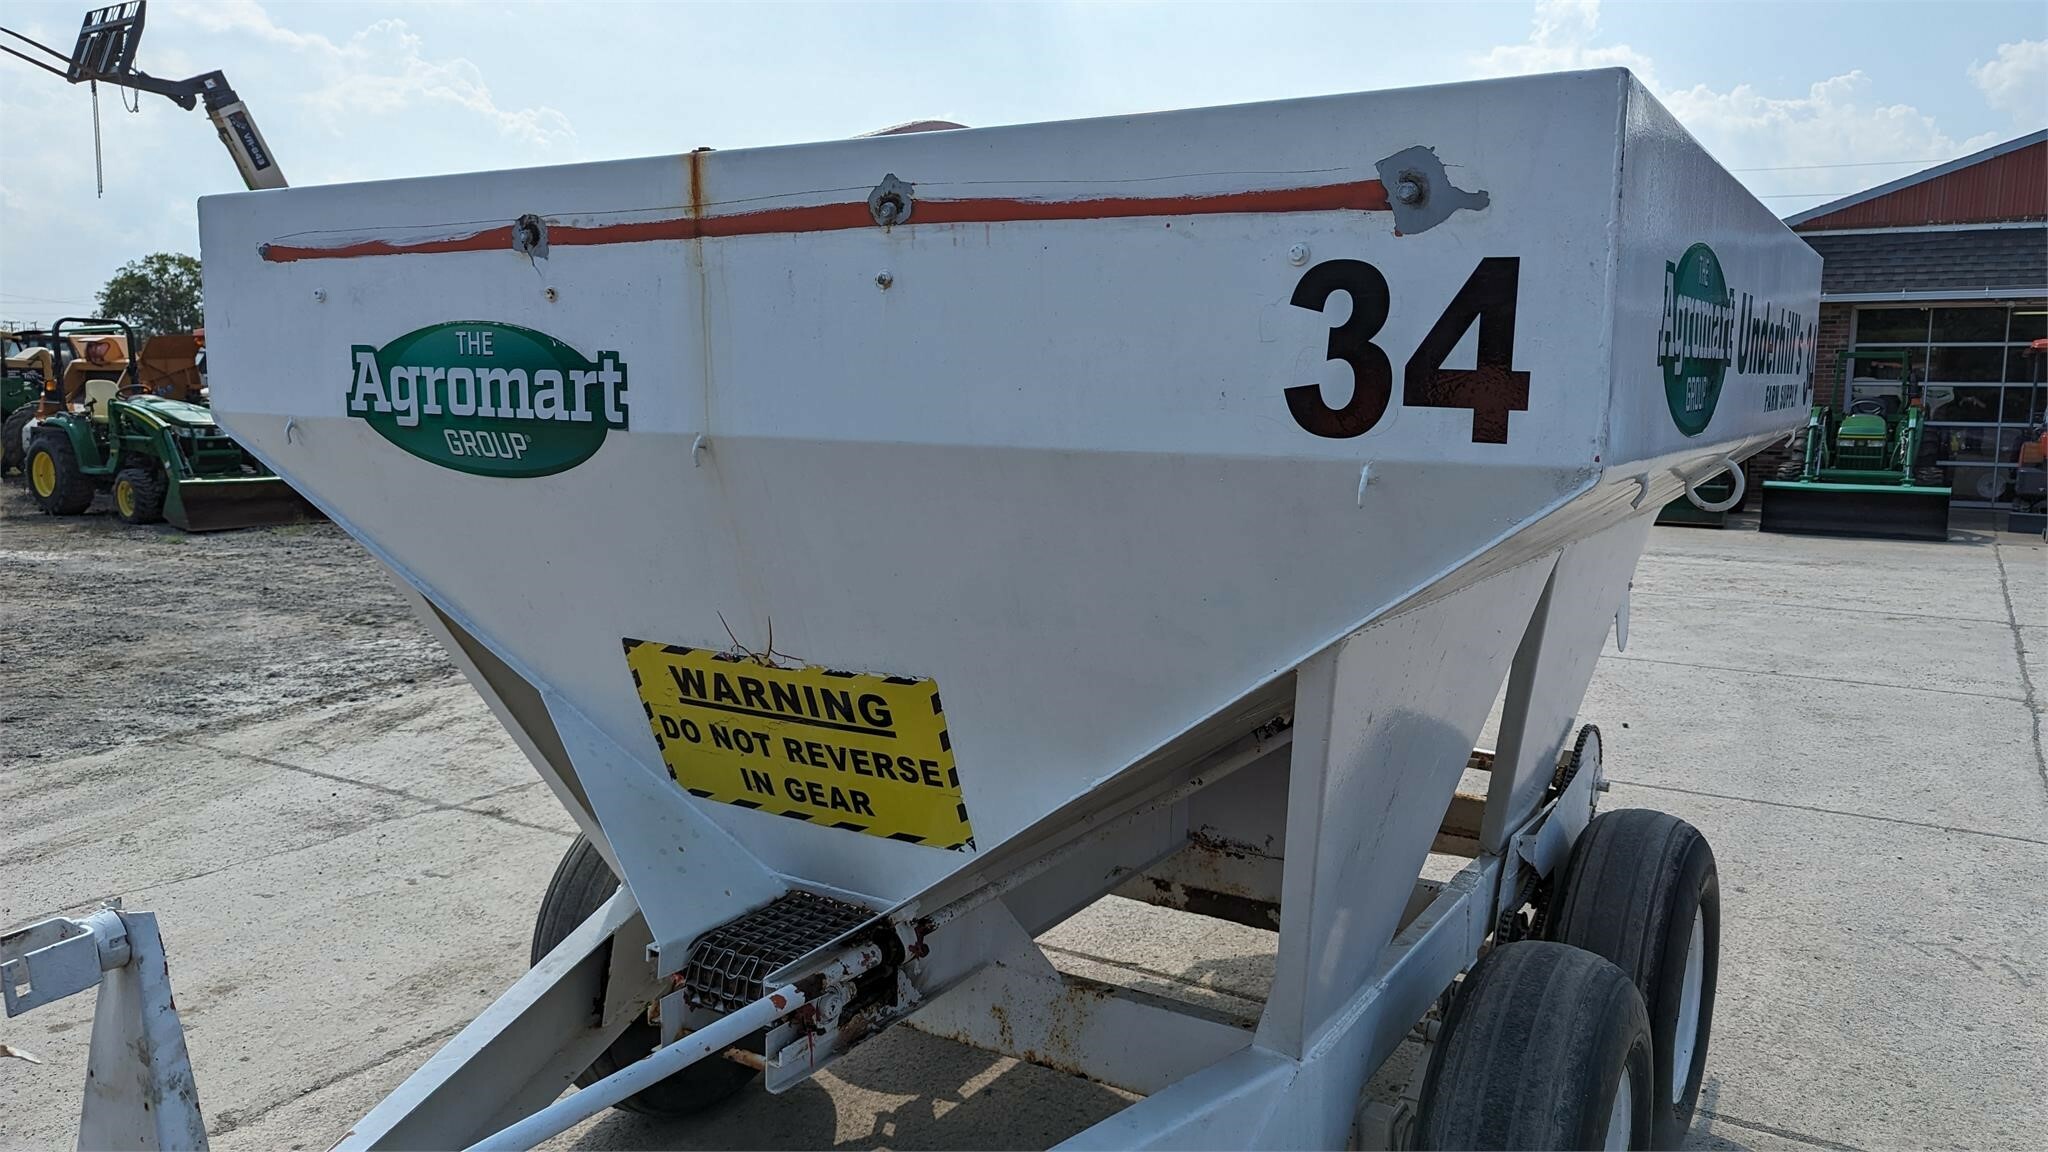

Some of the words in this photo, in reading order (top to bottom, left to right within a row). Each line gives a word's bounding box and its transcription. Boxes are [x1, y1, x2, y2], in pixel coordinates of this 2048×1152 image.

[455, 331, 494, 356] THE
[1284, 256, 1531, 445] 34
[1659, 271, 1734, 376] Agromart
[1737, 292, 1804, 376] Underhill's
[351, 351, 625, 427] Agromart
[1685, 376, 1708, 412] GROUP
[1763, 385, 1780, 413] FARM
[1779, 384, 1799, 410] SUPPLY
[668, 665, 894, 728] WARNING
[659, 714, 701, 744] DO
[709, 723, 771, 758] NOT
[783, 737, 944, 788] REVERSE
[741, 767, 775, 796] IN
[784, 777, 876, 817] GEAR
